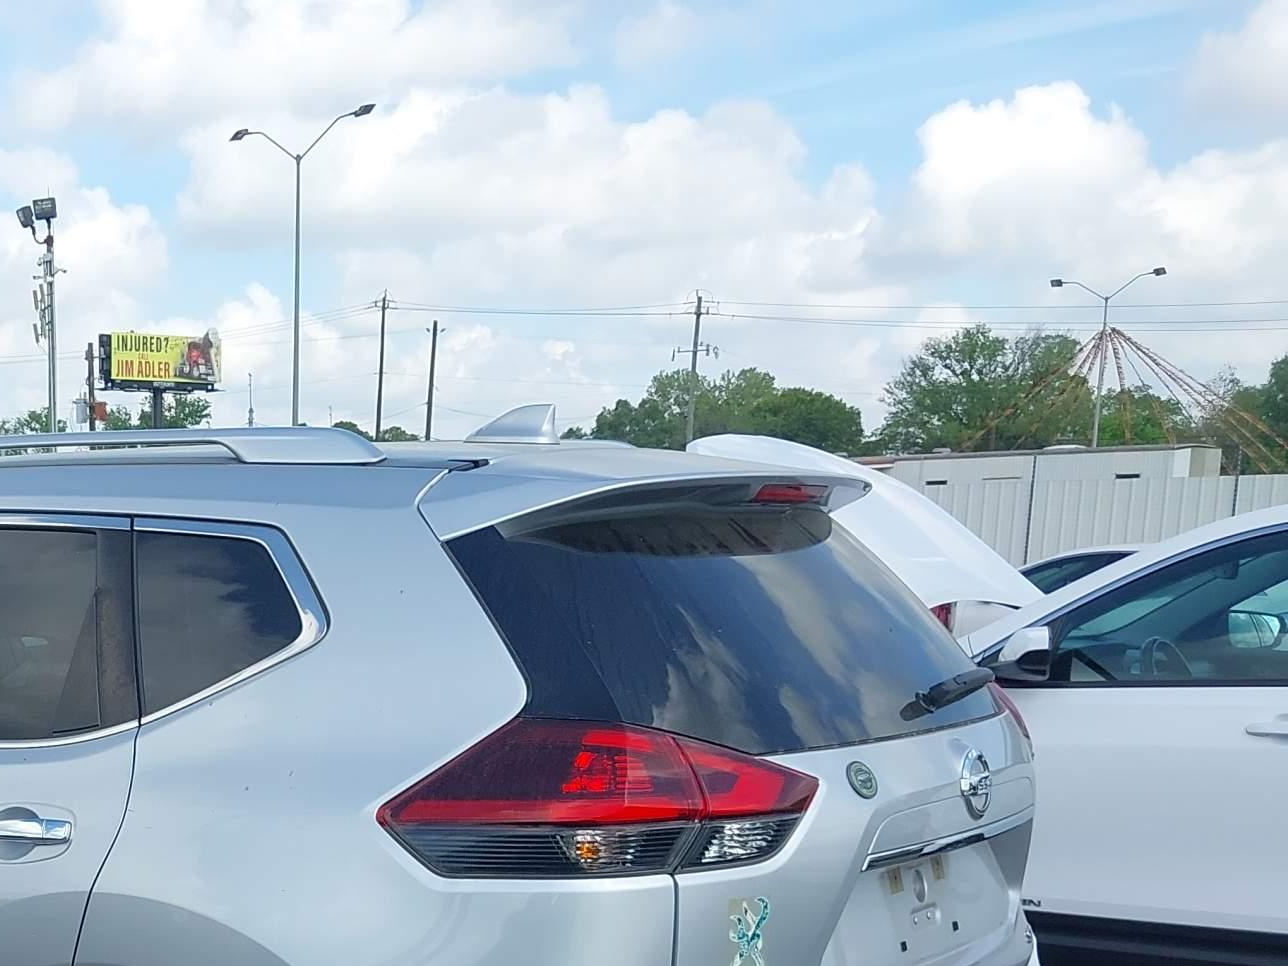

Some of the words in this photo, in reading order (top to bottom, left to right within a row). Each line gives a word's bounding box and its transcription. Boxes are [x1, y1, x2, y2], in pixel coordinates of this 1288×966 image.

[116, 335, 169, 353] INJURED?
[116, 360, 134, 377] JIM
[137, 361, 170, 379] ADLER
